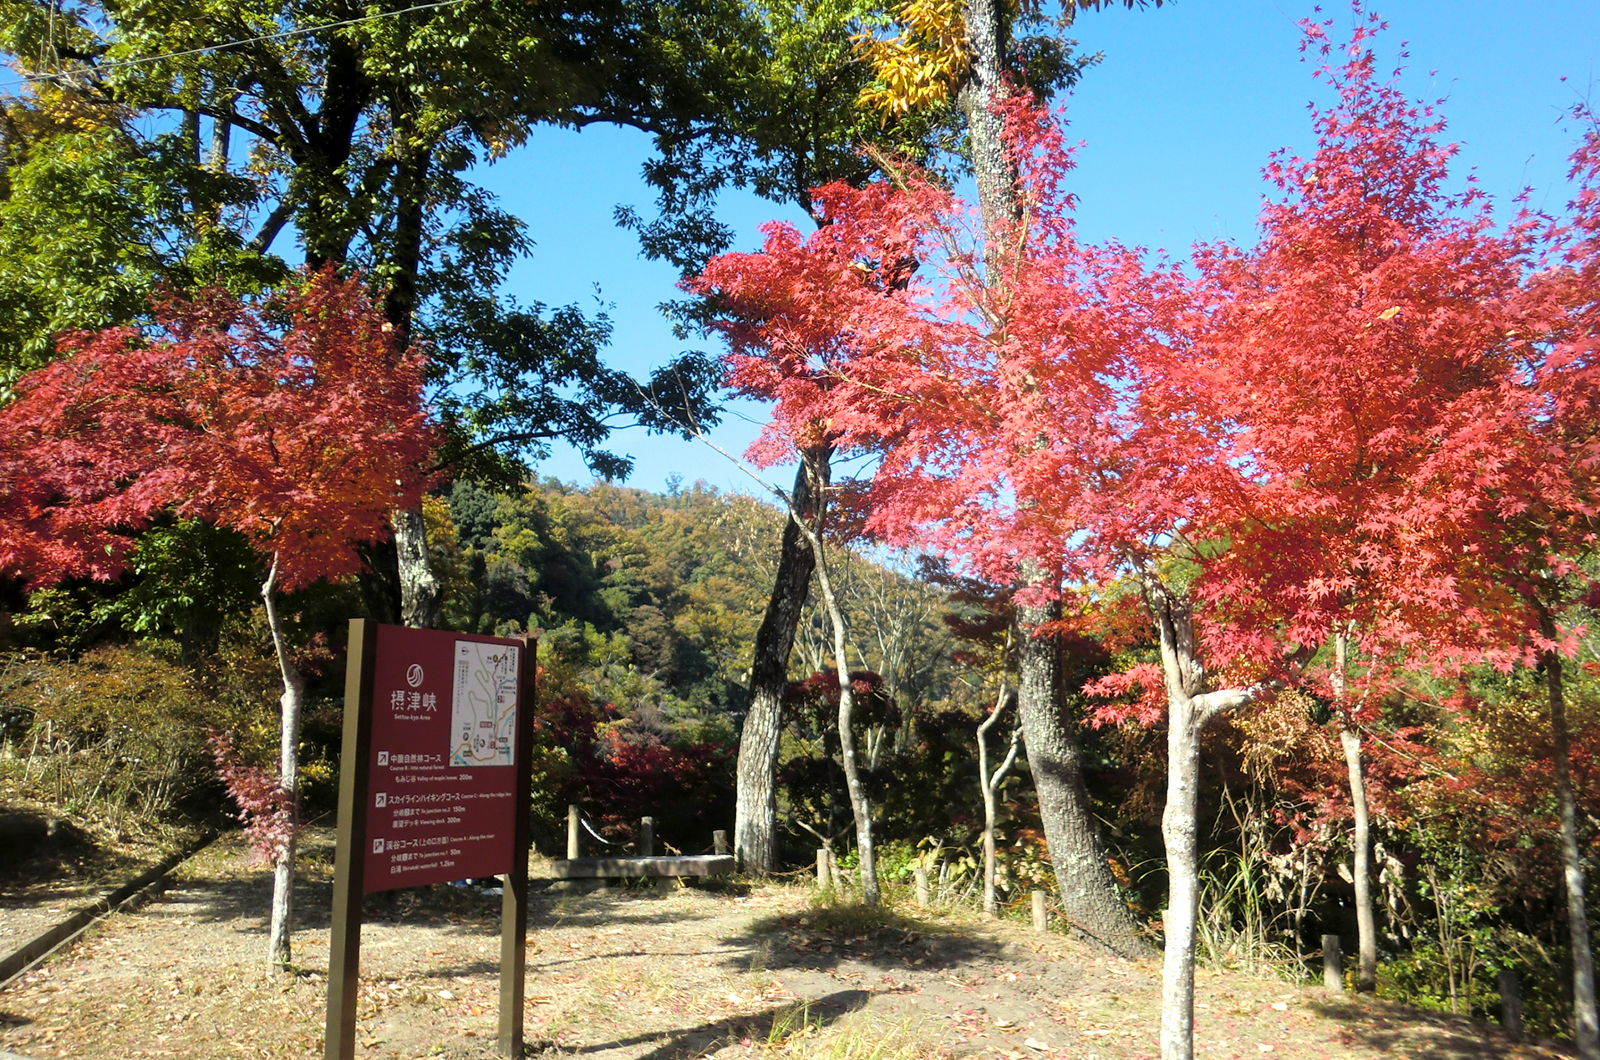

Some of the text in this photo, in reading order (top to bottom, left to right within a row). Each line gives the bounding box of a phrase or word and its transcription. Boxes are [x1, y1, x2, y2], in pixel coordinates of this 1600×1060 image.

[391, 690, 437, 712] 摂津峡
[388, 792, 461, 804] スカイラインハイキングコース
[440, 859, 455, 867] 1.2km
